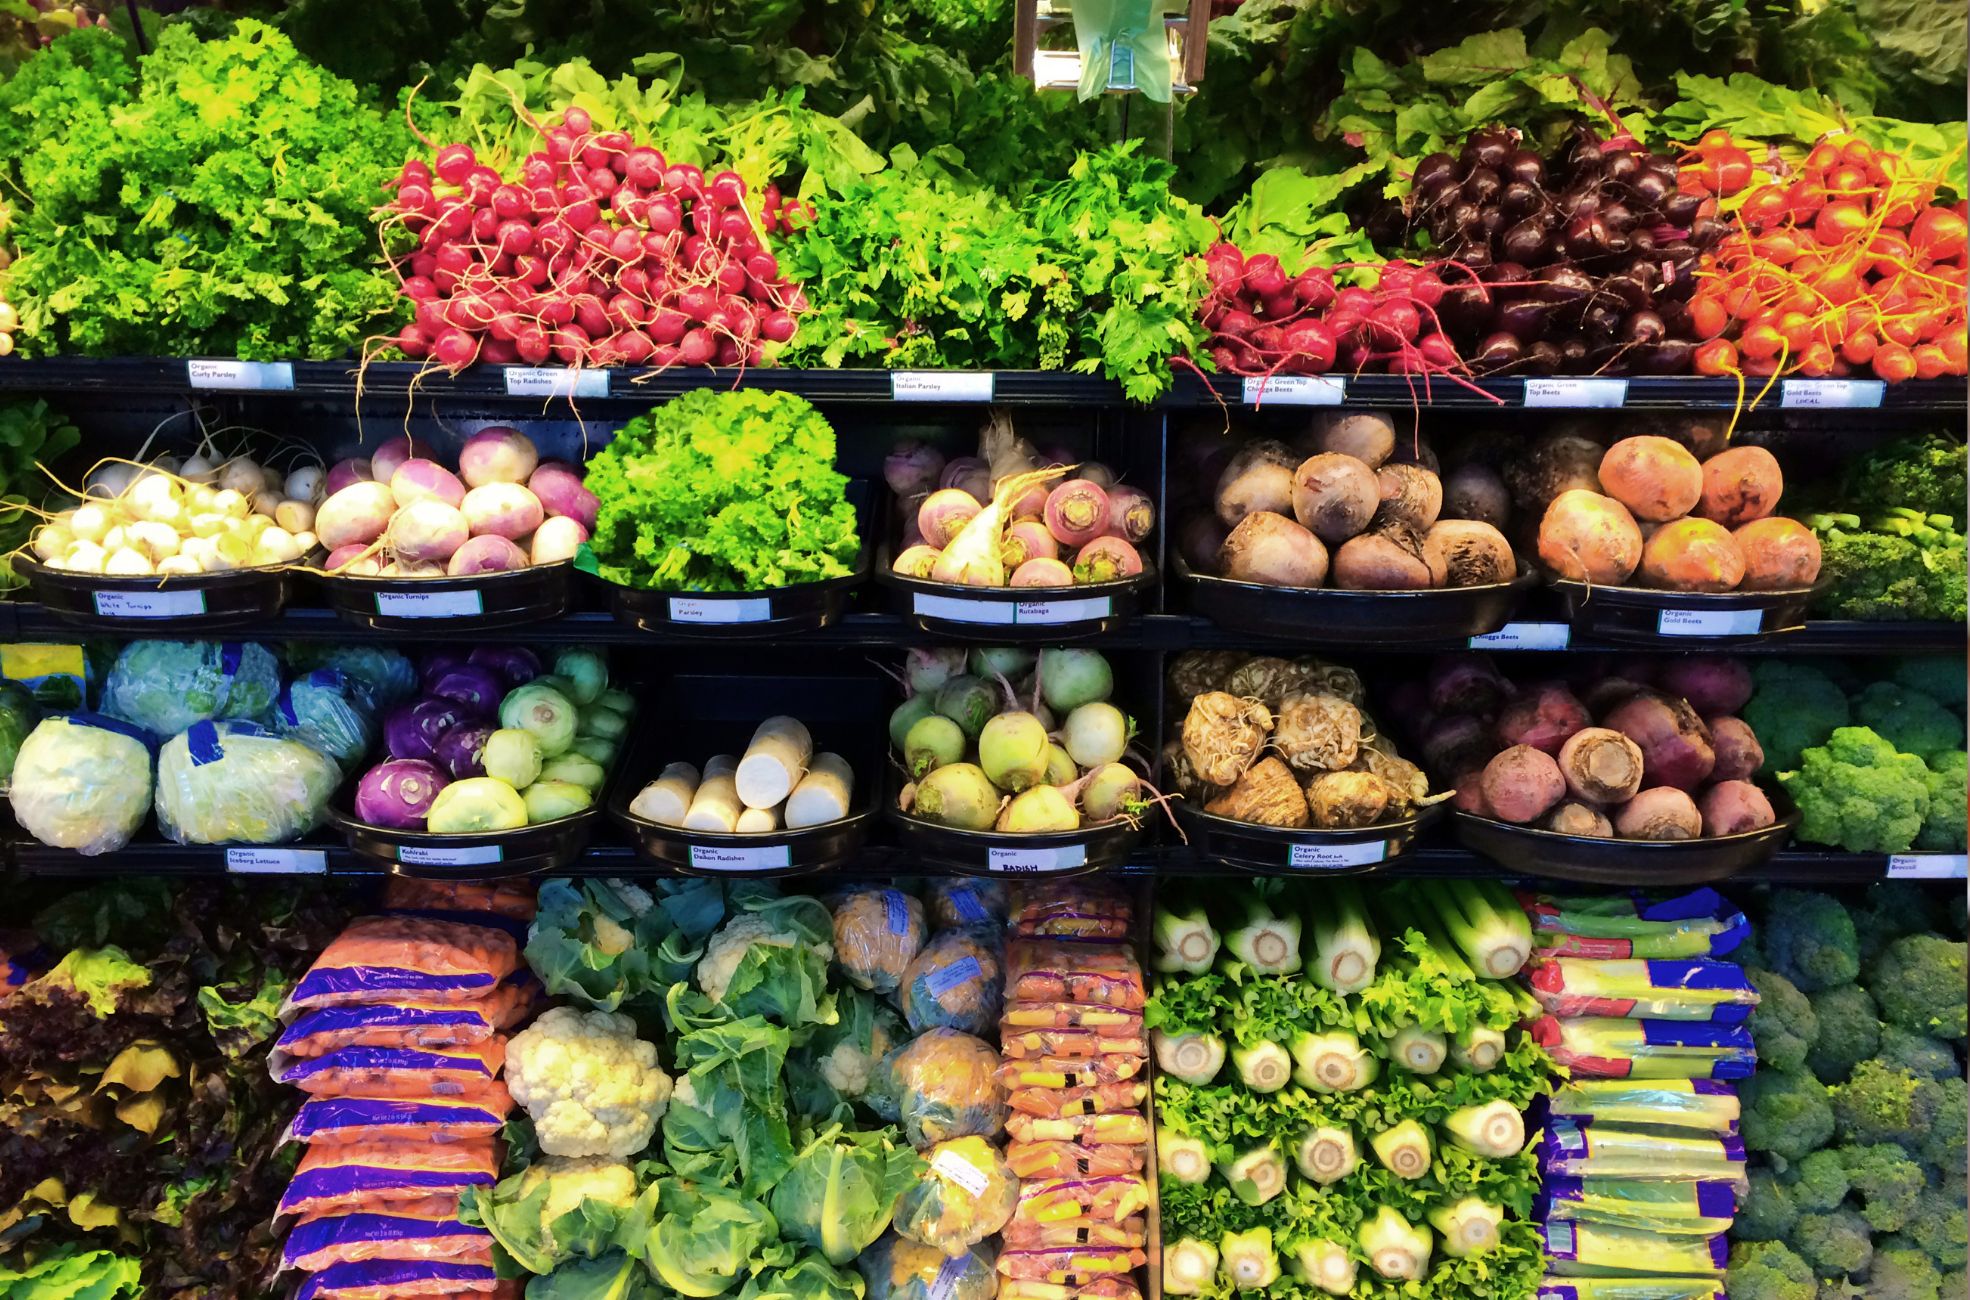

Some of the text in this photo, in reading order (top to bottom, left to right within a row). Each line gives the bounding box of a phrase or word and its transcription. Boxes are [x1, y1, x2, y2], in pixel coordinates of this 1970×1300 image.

[192, 371, 236, 380] Curly Parsley
[510, 378, 522, 386] Top
[1247, 378, 1273, 386] Orgnic
[918, 383, 940, 391] Parsley
[98, 592, 124, 600] Organic
[380, 592, 430, 600] Organic Turnips
[1664, 610, 1692, 618] Organic
[230, 850, 255, 858] Organic
[693, 846, 719, 855] Organic
[1294, 852, 1316, 860] Celery
[230, 857, 254, 865] Iceberg
[1002, 864, 1038, 872] RADISH
